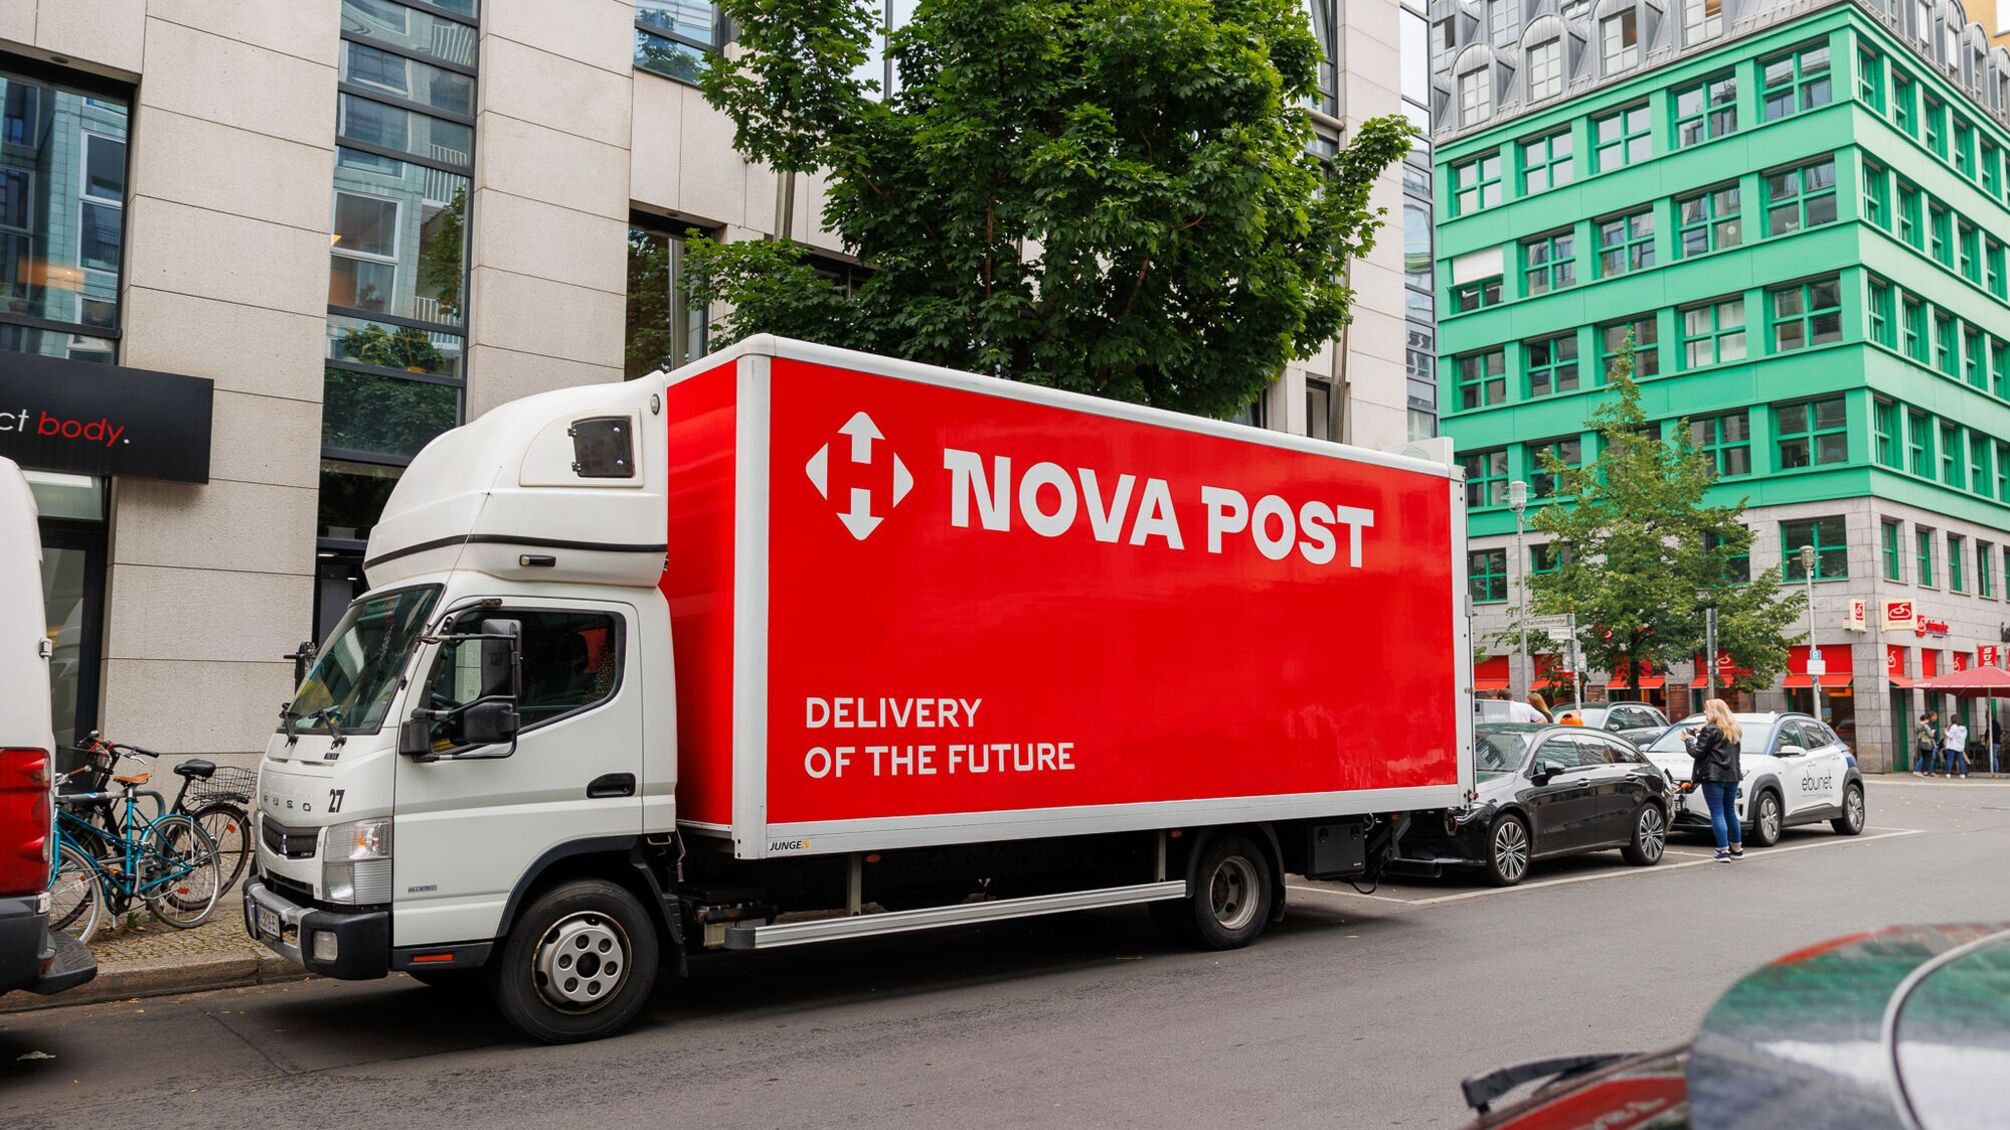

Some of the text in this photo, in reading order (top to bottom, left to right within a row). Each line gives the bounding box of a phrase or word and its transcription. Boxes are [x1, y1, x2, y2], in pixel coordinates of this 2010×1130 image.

[37, 410, 130, 448] body.
[944, 448, 1374, 568] NOVA POST
[807, 697, 981, 728] DELIVERY
[805, 743, 1075, 778] OF THE FUTURE
[1801, 768, 1833, 791] ebunet
[263, 795, 312, 812] FUSO
[328, 788, 345, 813] 27
